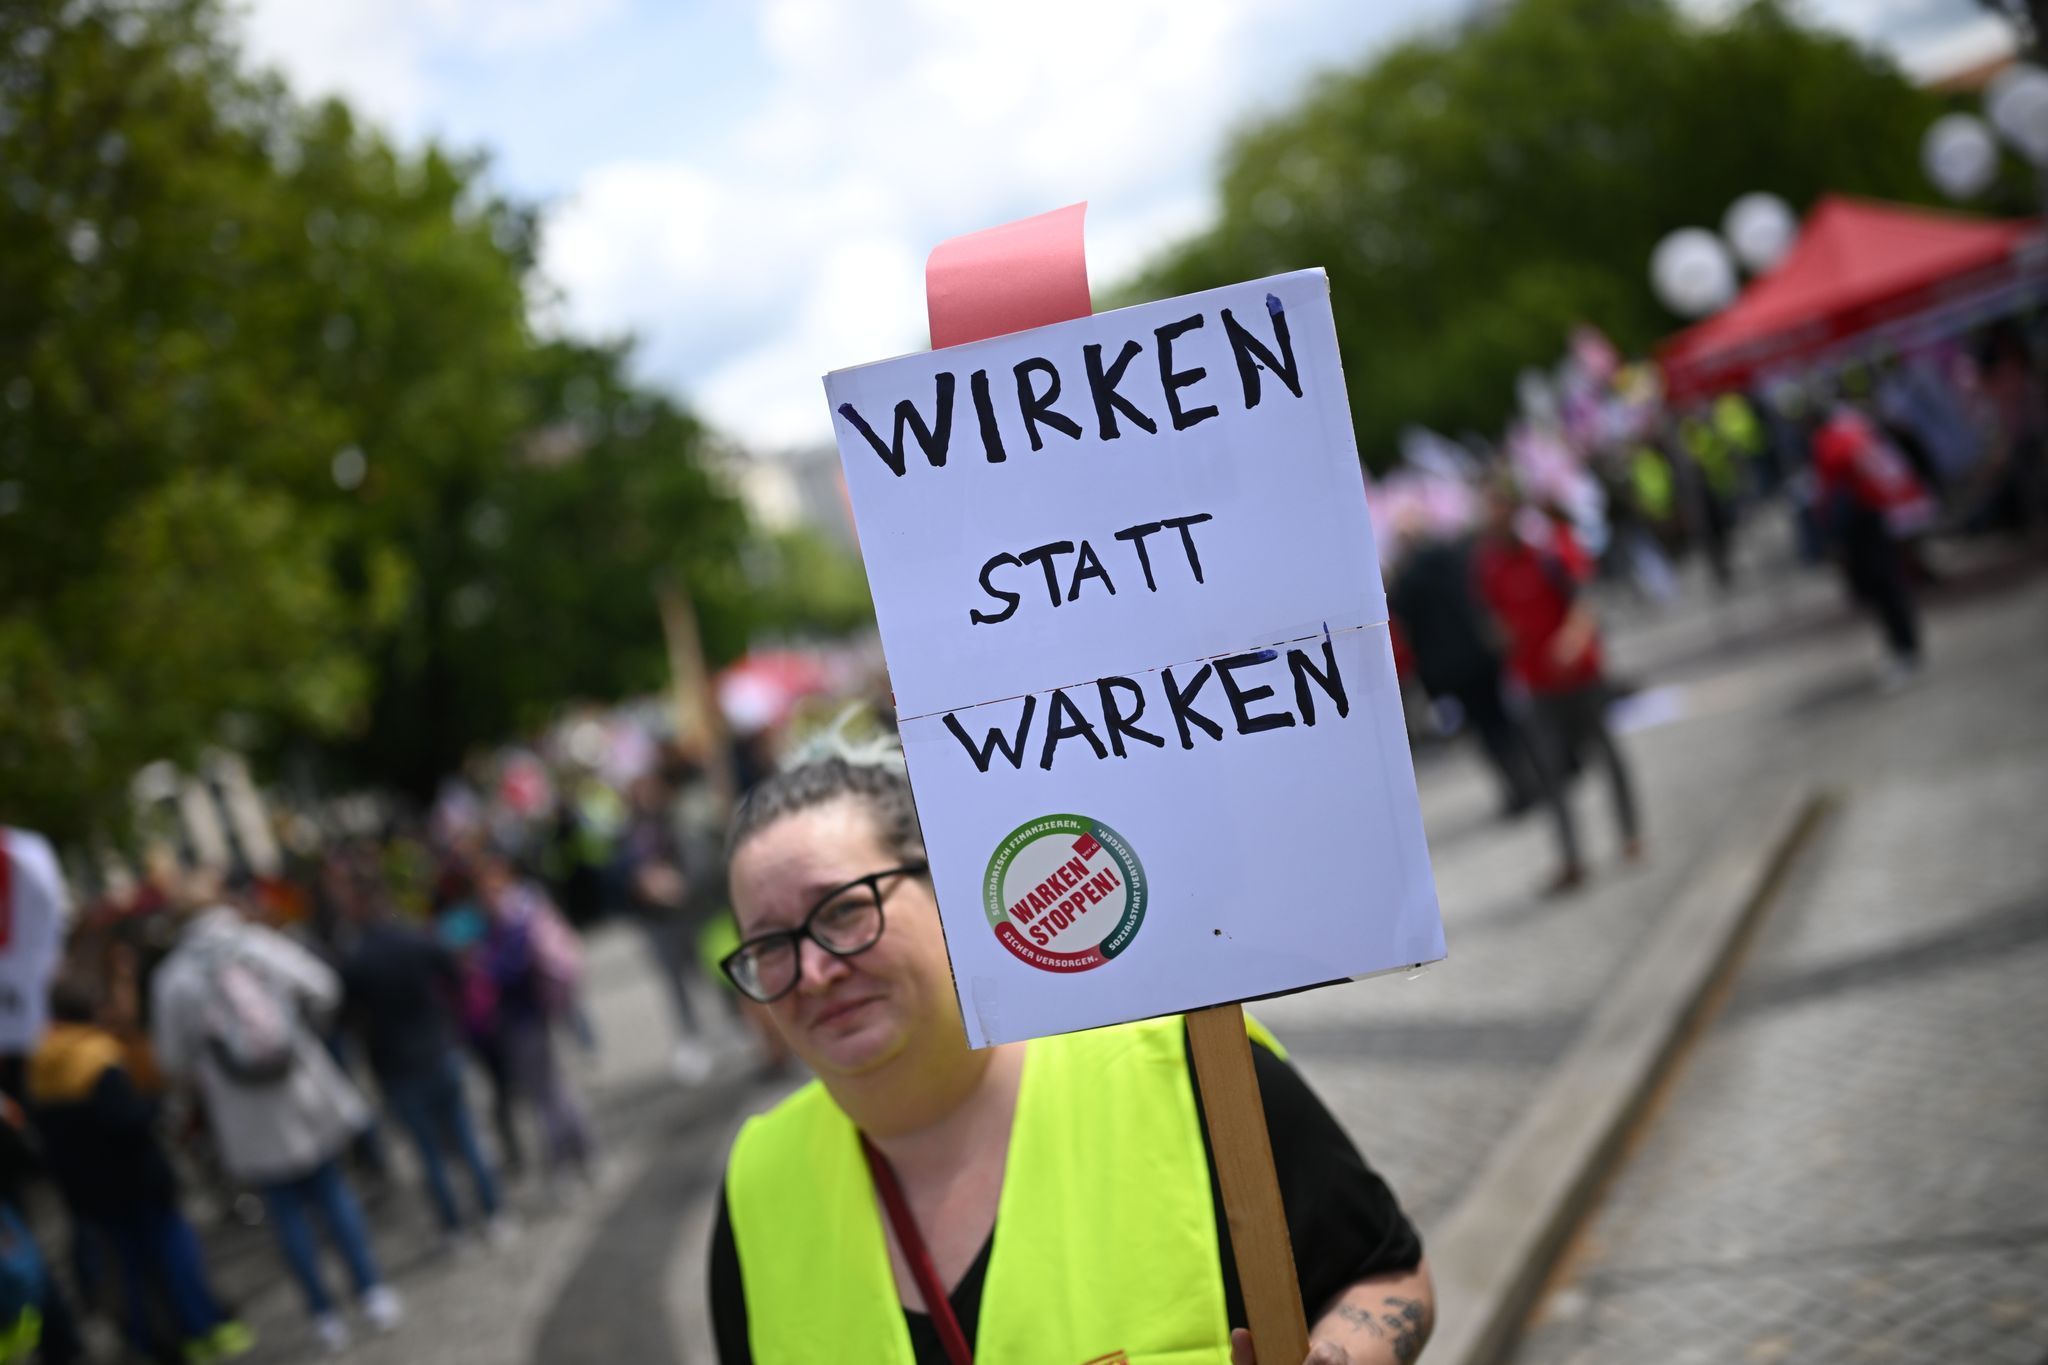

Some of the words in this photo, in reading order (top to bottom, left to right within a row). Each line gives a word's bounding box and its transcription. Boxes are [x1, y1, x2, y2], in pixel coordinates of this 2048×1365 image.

[838, 292, 1304, 477] WIRKEN
[970, 512, 1213, 626] STATT
[942, 621, 1349, 773] WARKEN
[988, 847, 1012, 916] SOLIDARISCH
[1010, 820, 1081, 849] FINANZIEREN.
[1008, 856, 1090, 925] WARKEN
[1098, 828, 1141, 889] VERTEIDIGEN.
[1028, 866, 1121, 946] STOPPEN!
[1108, 890, 1141, 951] SOZIALSTAAT
[1002, 931, 1035, 960] SICHER
[1035, 953, 1099, 968] VERSORGEN.
